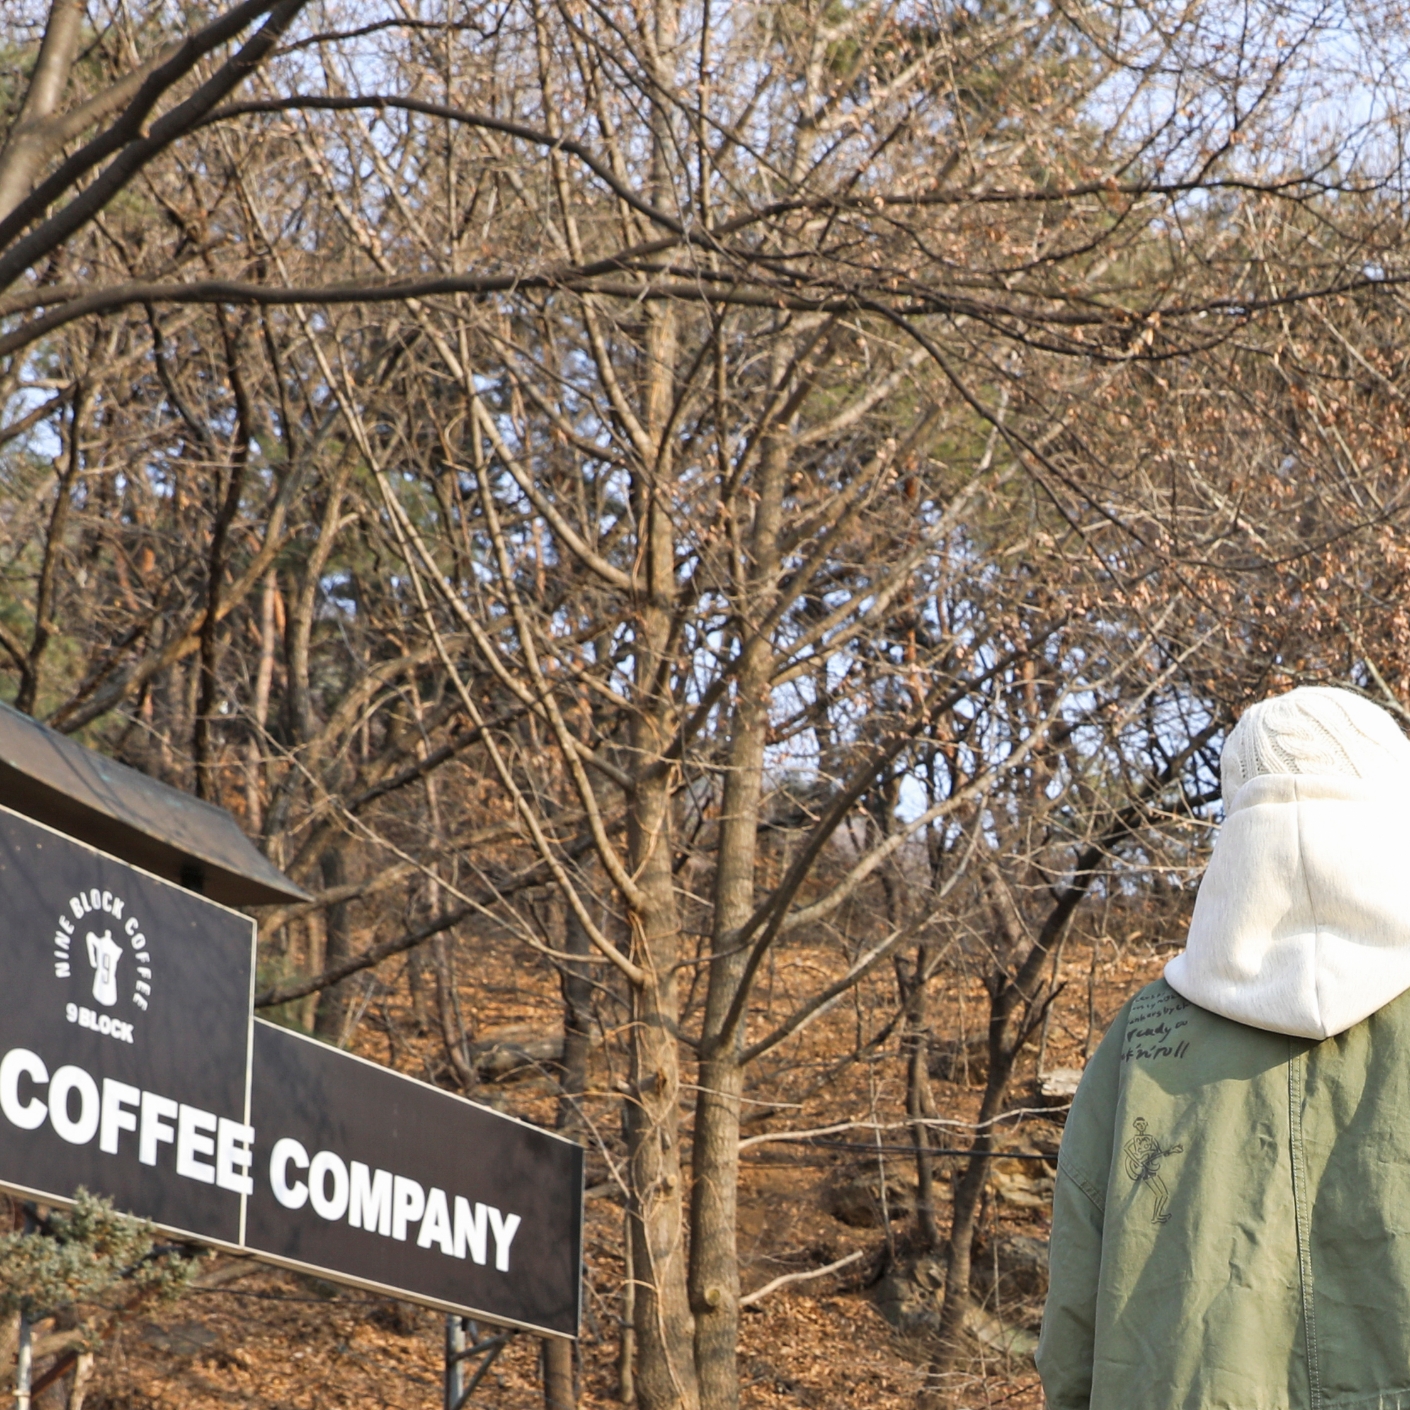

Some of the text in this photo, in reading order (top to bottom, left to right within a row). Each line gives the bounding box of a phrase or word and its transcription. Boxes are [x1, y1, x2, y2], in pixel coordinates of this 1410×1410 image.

[54, 888, 152, 1012] NINE BLOCK COFFEE
[0, 1048, 522, 1272] COFFEE COMPANY
